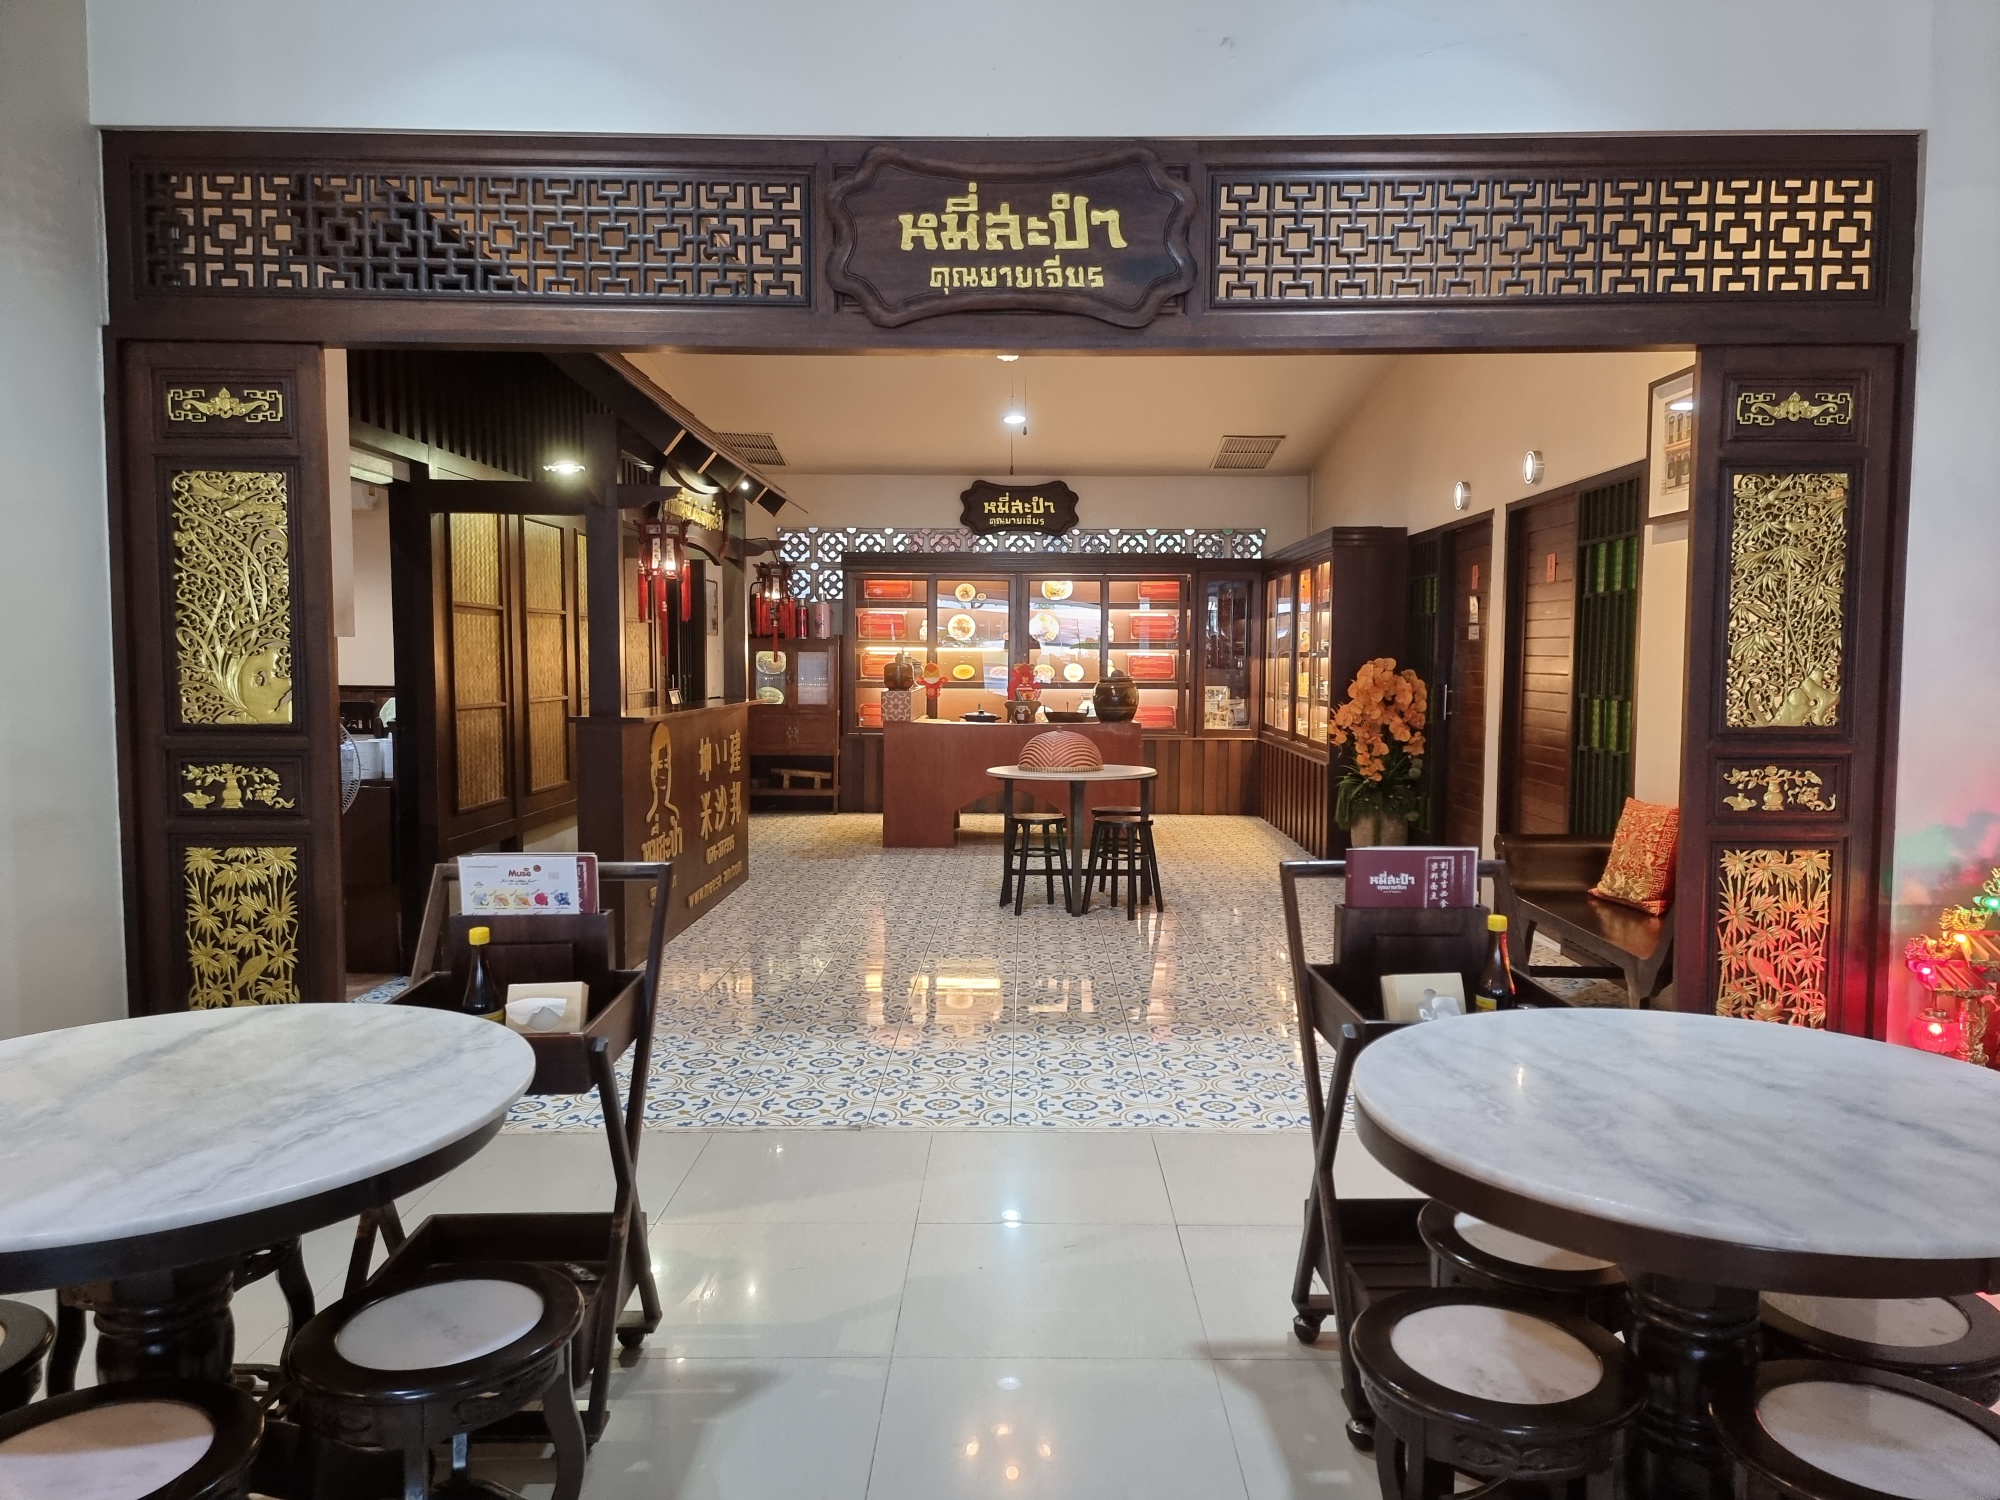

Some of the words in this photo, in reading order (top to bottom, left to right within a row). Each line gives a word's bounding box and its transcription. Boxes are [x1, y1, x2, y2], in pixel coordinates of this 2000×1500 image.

[898, 181, 1128, 251] หมี่สะปำ
[929, 254, 1105, 295] คุณยายเจียร
[984, 492, 1055, 514] หมี่สะปำ
[700, 781, 742, 841] 米沙邦
[1369, 871, 1415, 885] หมี่สะปำ
